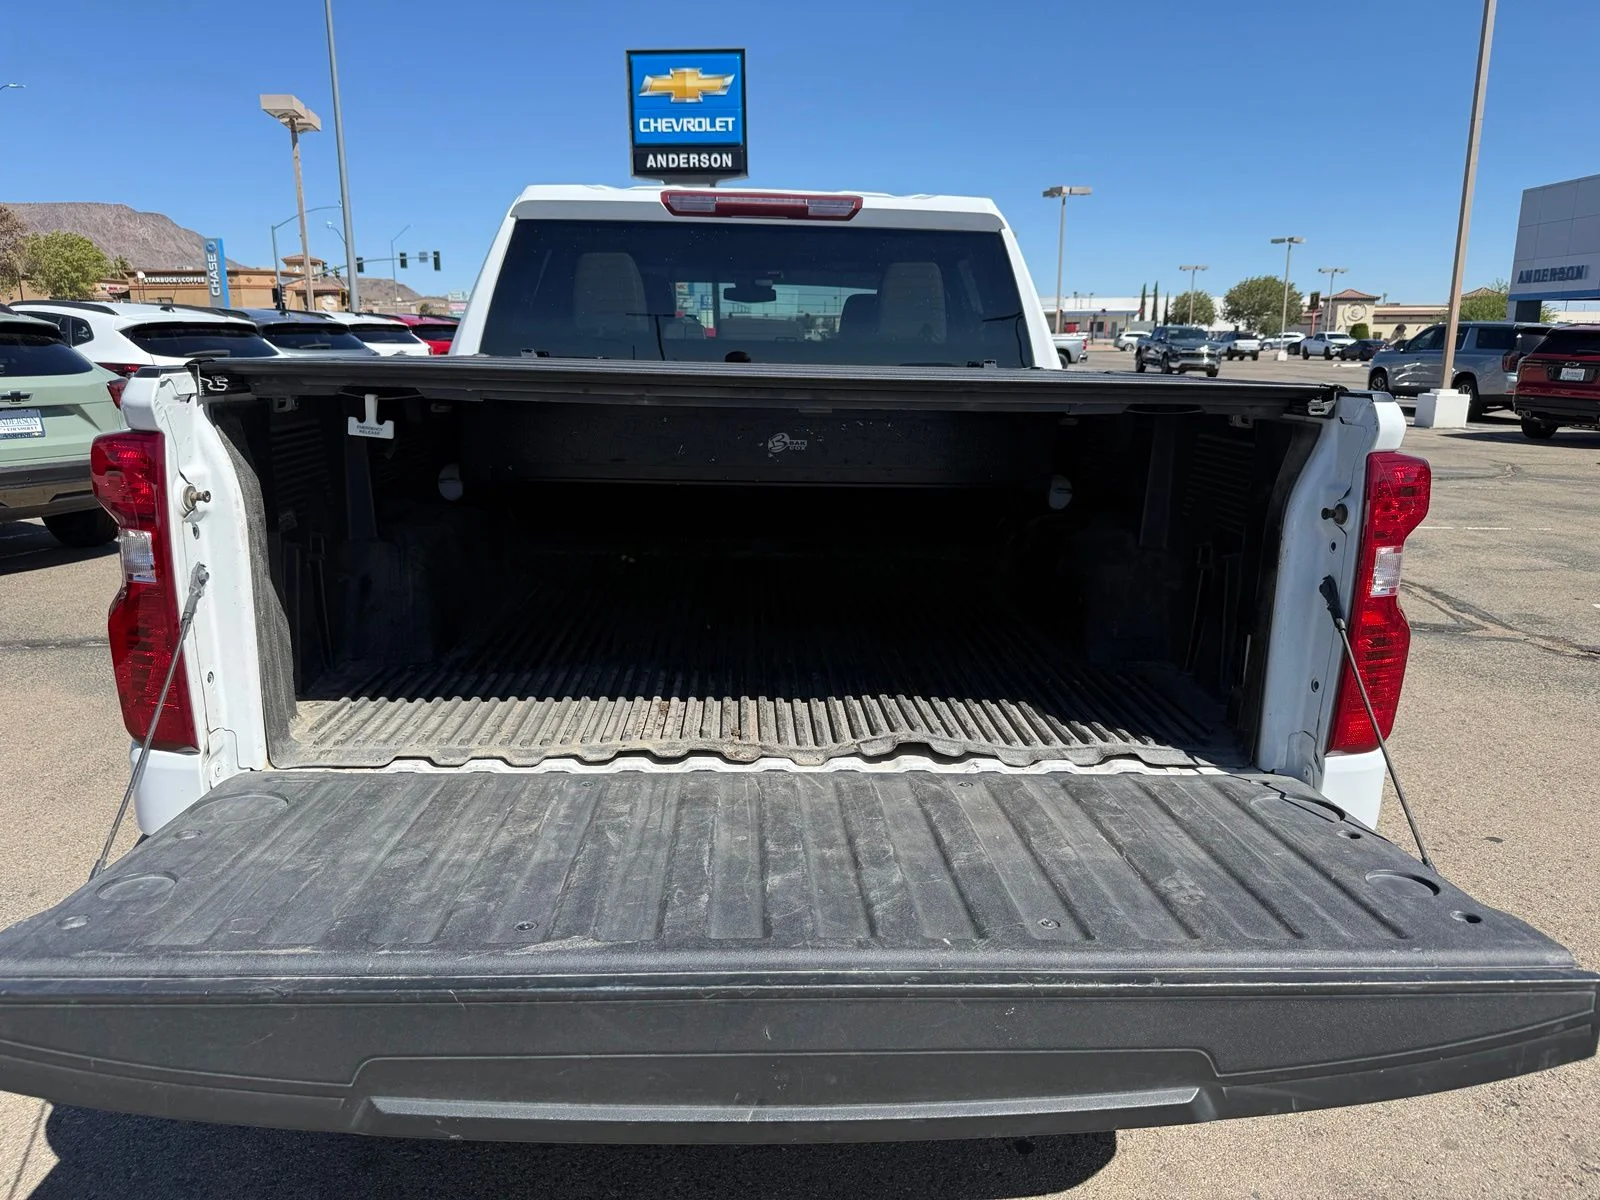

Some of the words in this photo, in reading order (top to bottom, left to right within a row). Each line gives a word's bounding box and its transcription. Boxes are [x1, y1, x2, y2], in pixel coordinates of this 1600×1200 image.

[639, 117, 736, 133] CHEVROLET
[646, 152, 732, 168] ANDERSON
[182, 276, 205, 285] COFFEE
[207, 253, 221, 297] CHASE
[1517, 264, 1588, 284] ANDERSON
[356, 424, 383, 432] EMERGENCY
